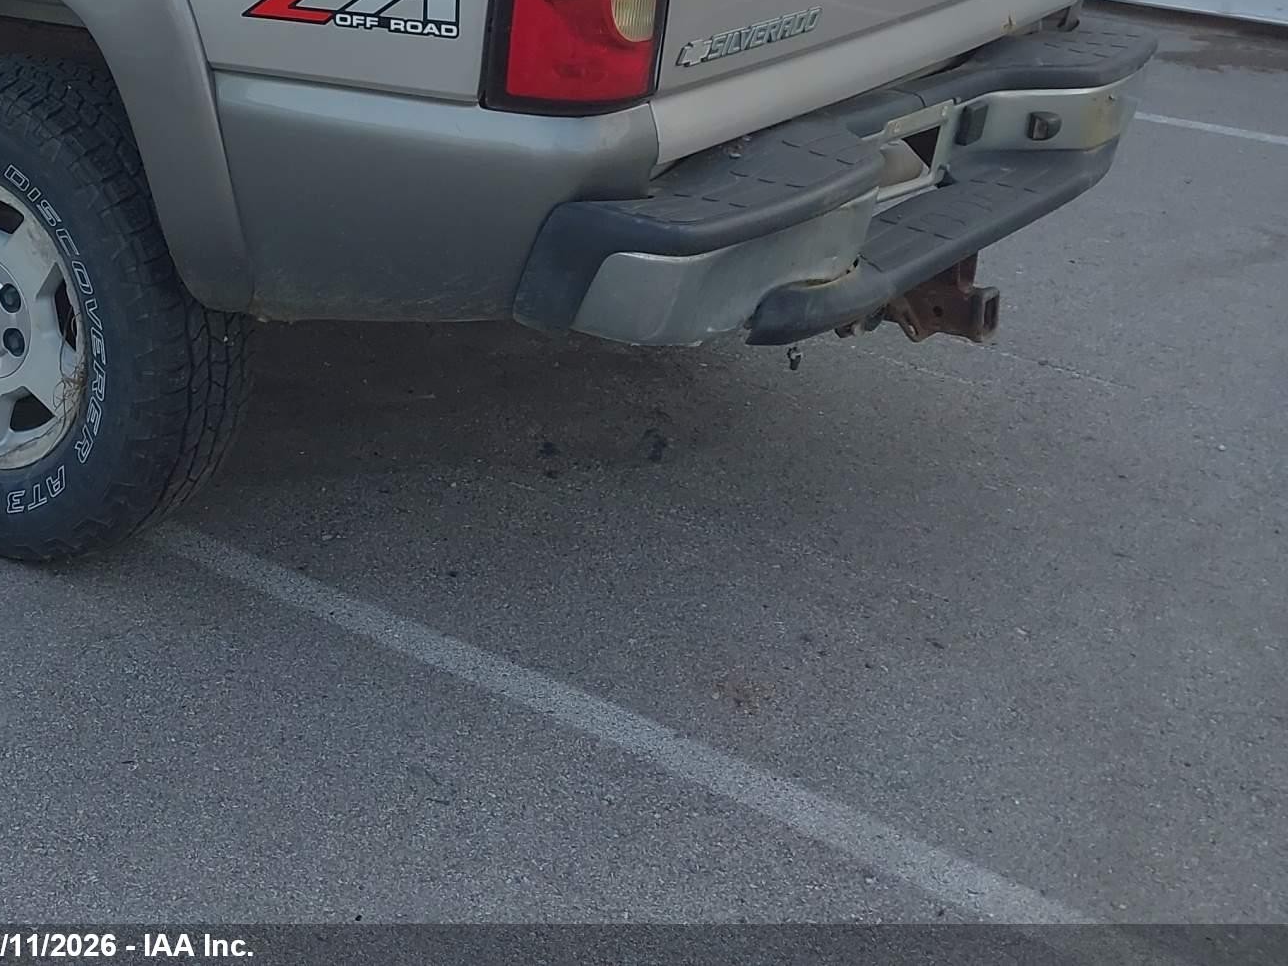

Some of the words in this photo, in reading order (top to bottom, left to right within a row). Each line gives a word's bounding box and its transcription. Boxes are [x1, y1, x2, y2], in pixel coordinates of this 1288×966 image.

[334, 12, 379, 29] OFF
[389, 18, 459, 38] ROAD
[707, 5, 823, 60] SILVERADO
[4, 164, 106, 464] DISCOVERER
[6, 465, 66, 514] AT3
